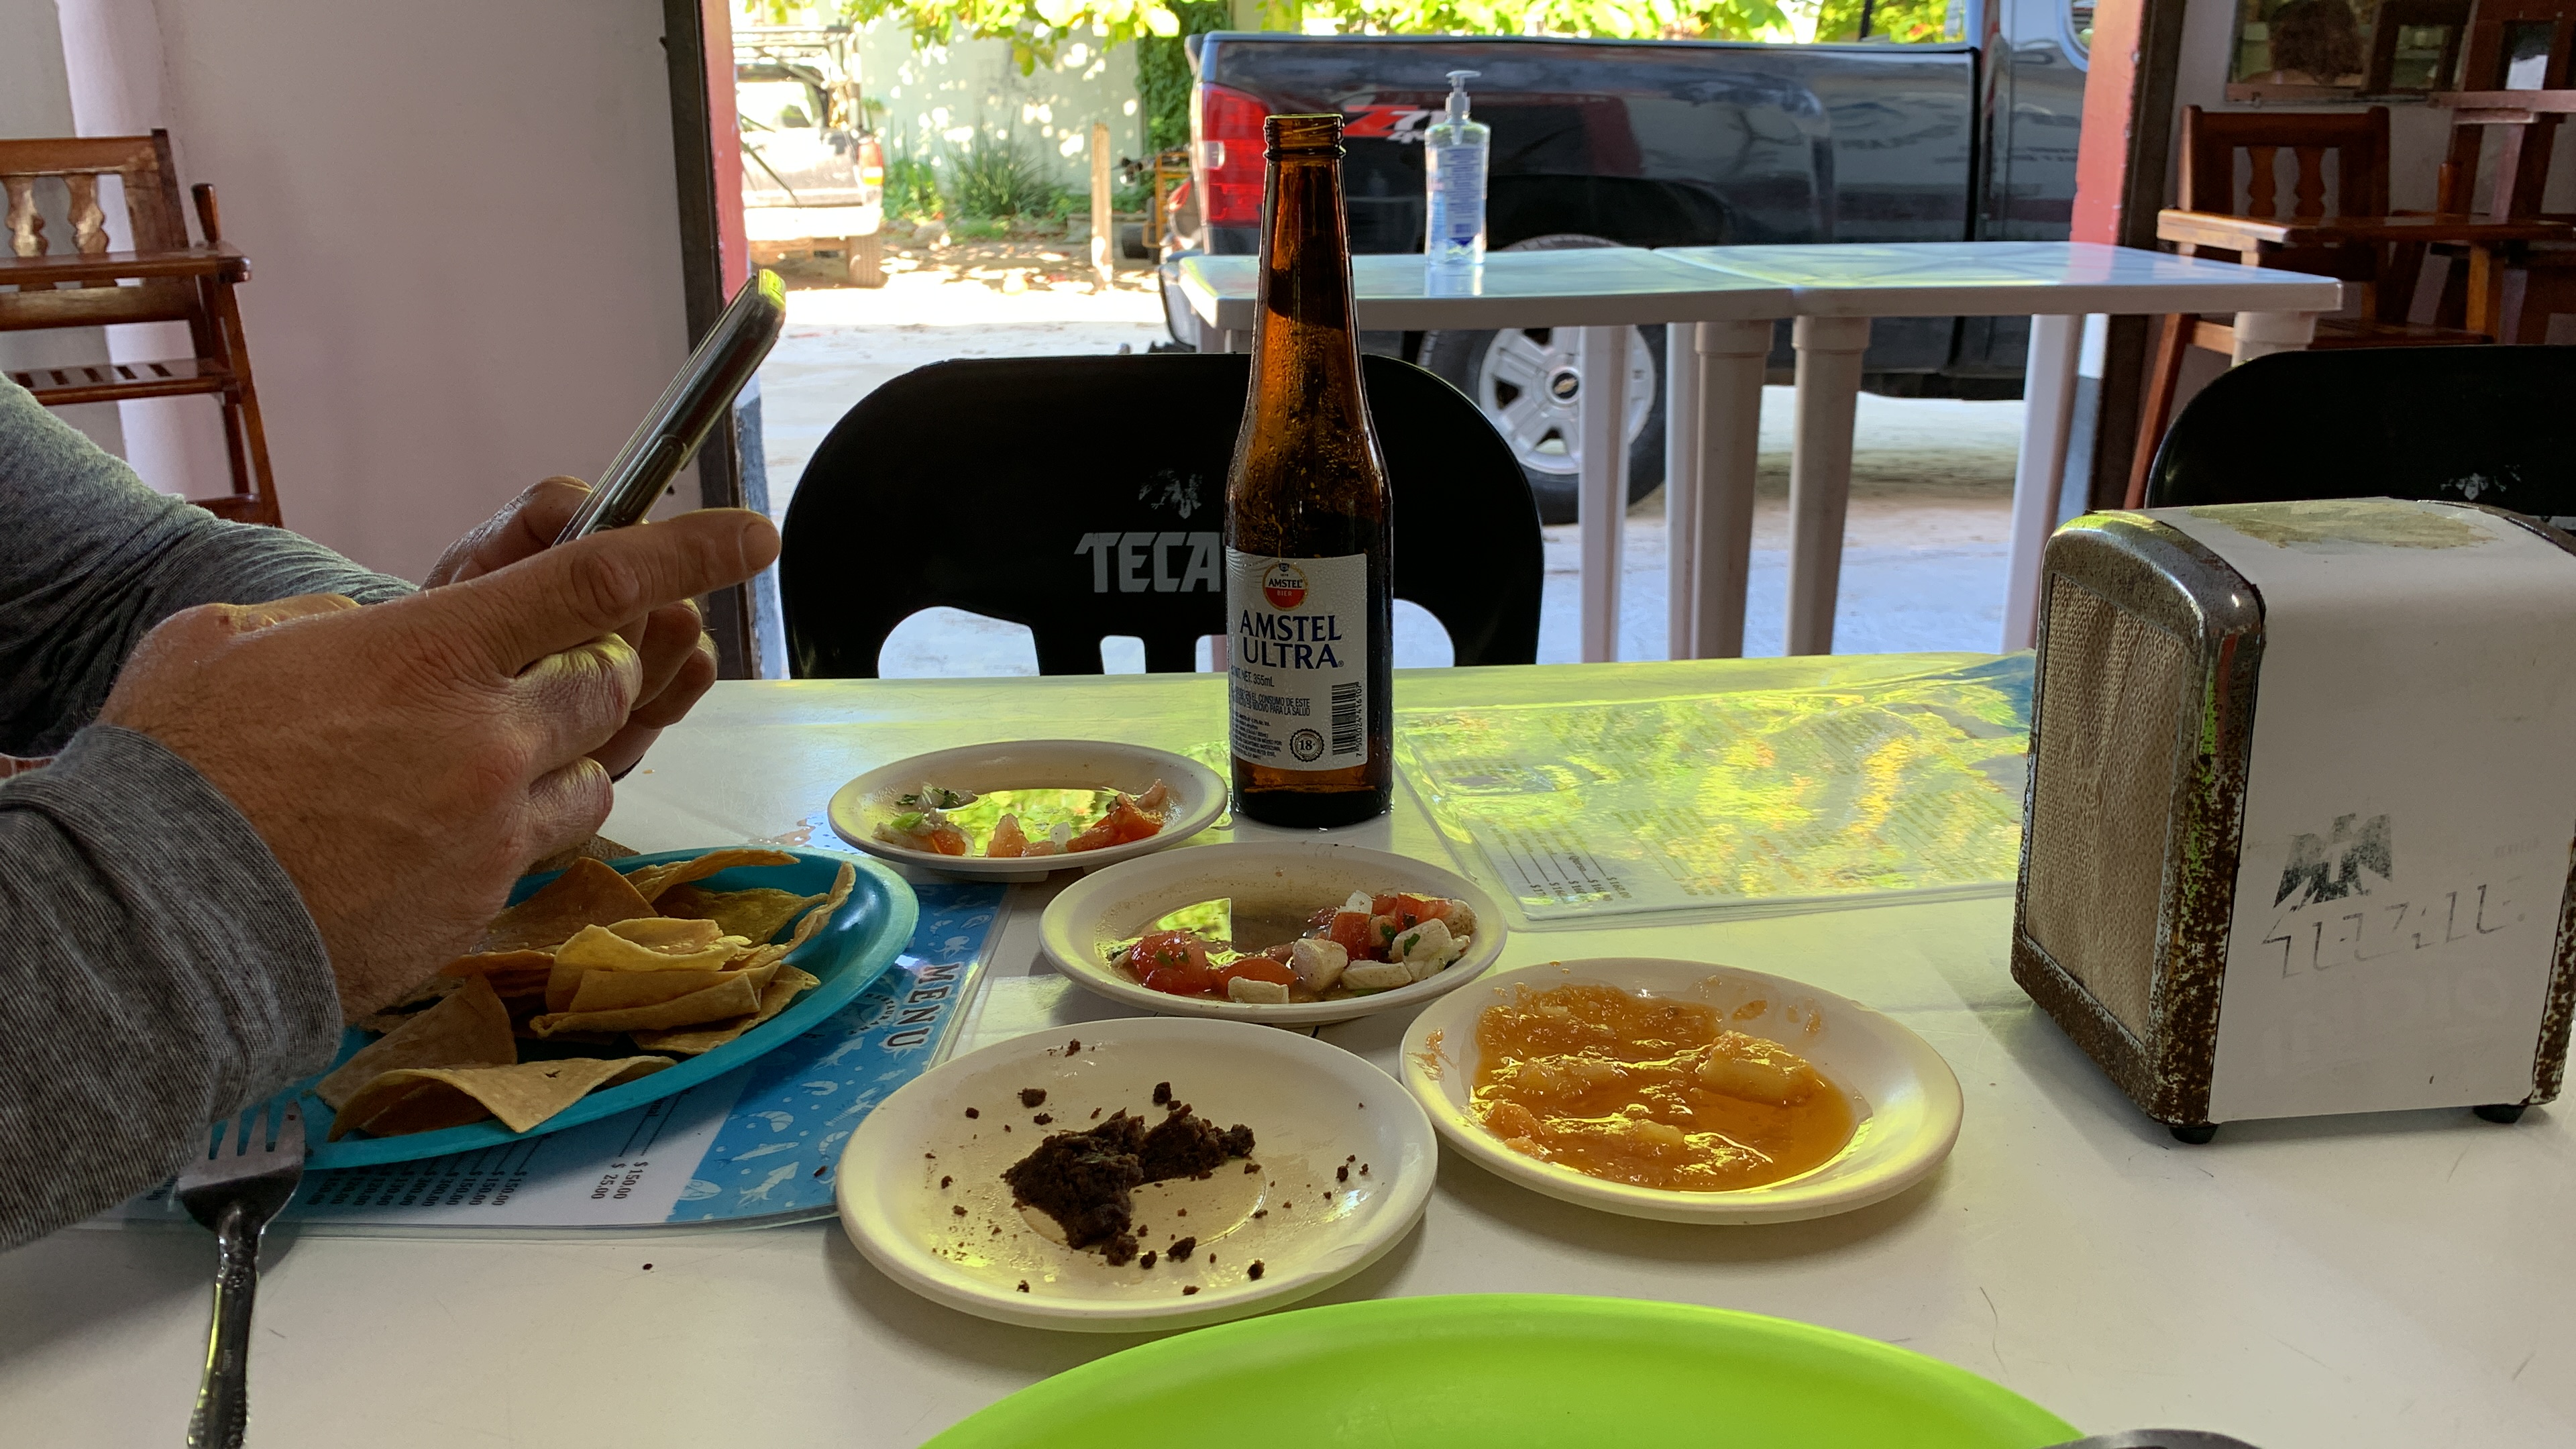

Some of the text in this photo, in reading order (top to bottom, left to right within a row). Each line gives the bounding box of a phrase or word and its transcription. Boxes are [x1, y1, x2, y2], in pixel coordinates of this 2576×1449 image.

[1074, 532, 1225, 593] TECA
[1269, 578, 1302, 588] AMSTEL
[1240, 610, 1342, 641] AMSTEL
[1243, 637, 1339, 669] ULTRA
[1284, 706, 1291, 716] LA
[1292, 706, 1310, 716] SALUD
[1286, 698, 1294, 707] DE
[1295, 698, 1310, 708] ESTE
[885, 962, 961, 1047] MENU
